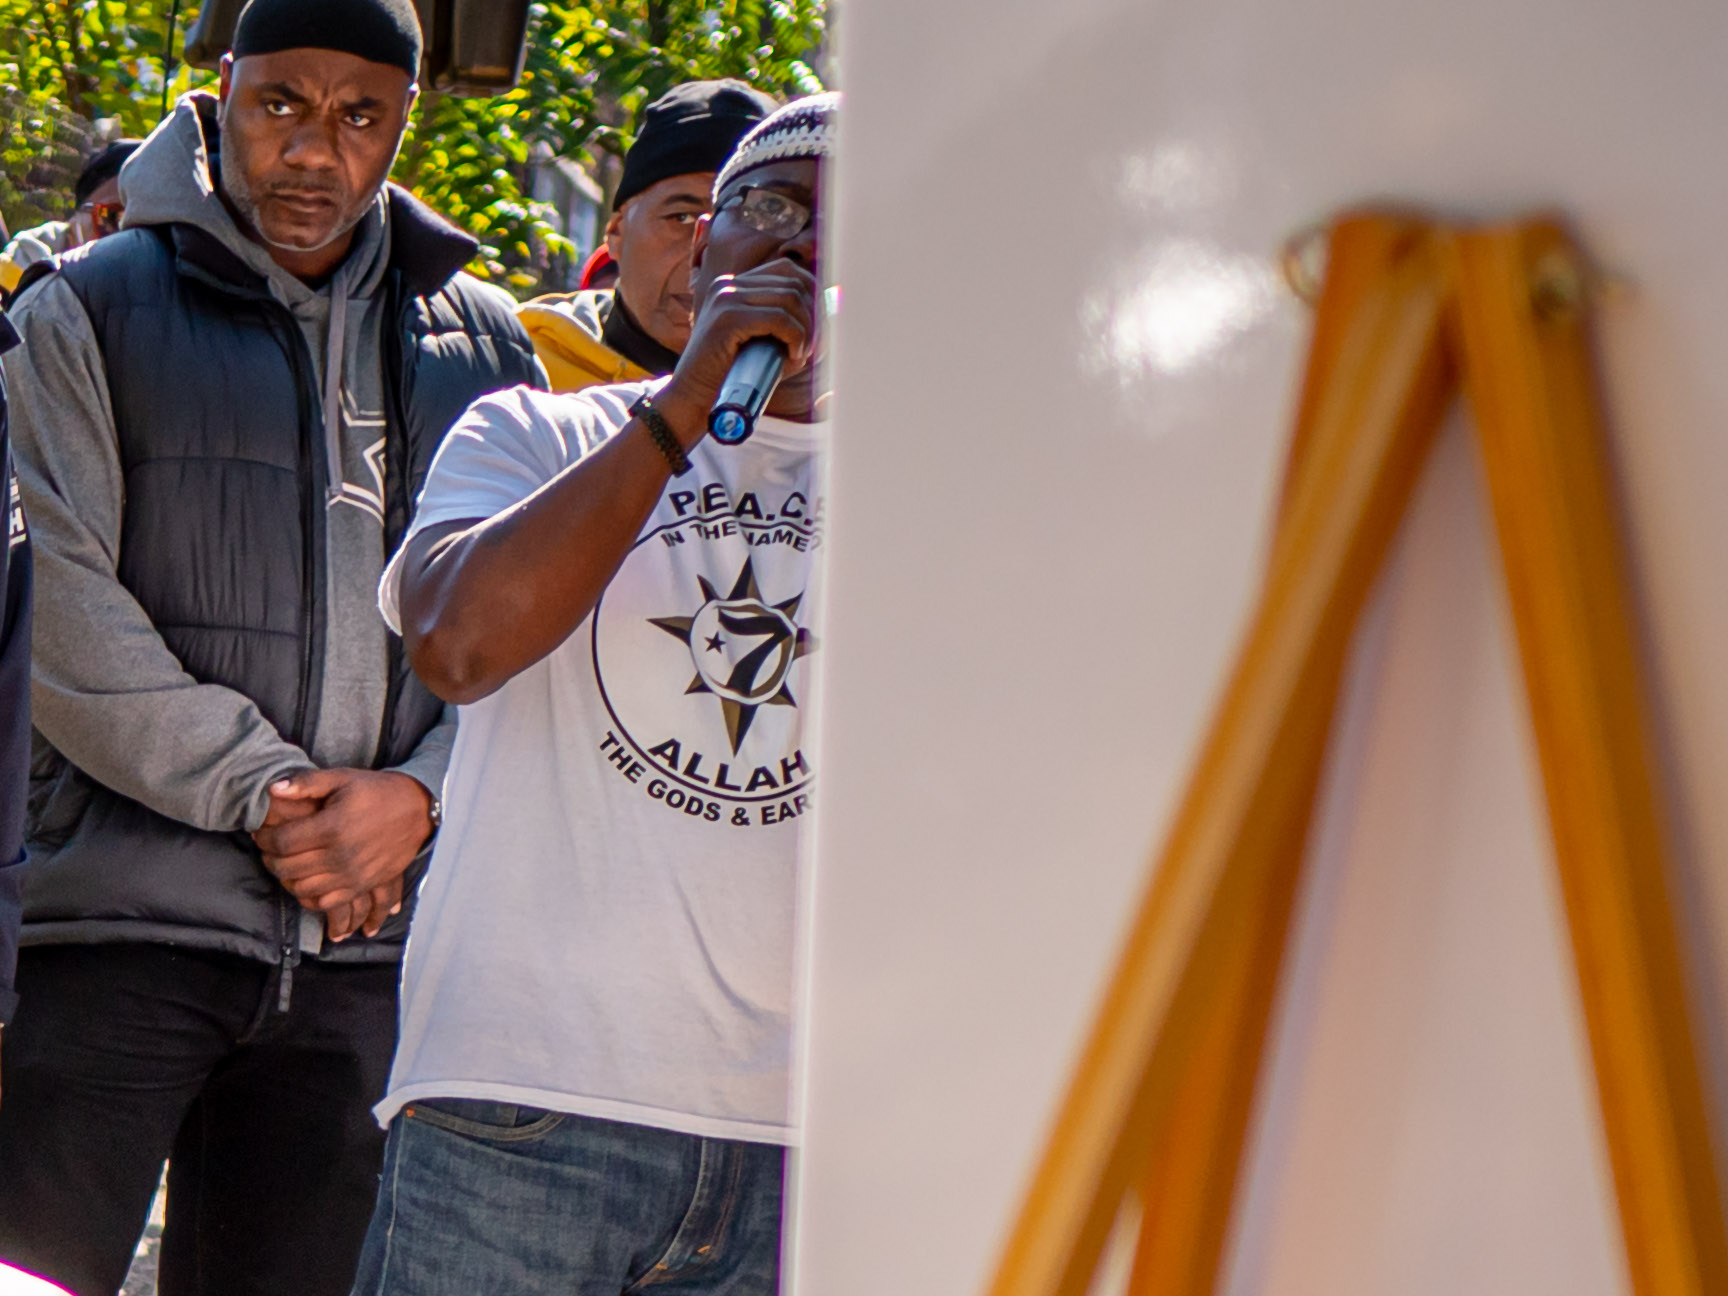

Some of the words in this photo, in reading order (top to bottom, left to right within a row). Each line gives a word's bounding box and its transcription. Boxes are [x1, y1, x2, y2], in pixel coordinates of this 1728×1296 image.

[659, 530, 686, 548] IN
[688, 520, 738, 541] THE
[743, 529, 810, 553] NAME
[599, 730, 647, 784] THE
[646, 778, 722, 822] GODS
[730, 806, 751, 826] &
[647, 737, 812, 793] ALLAH
